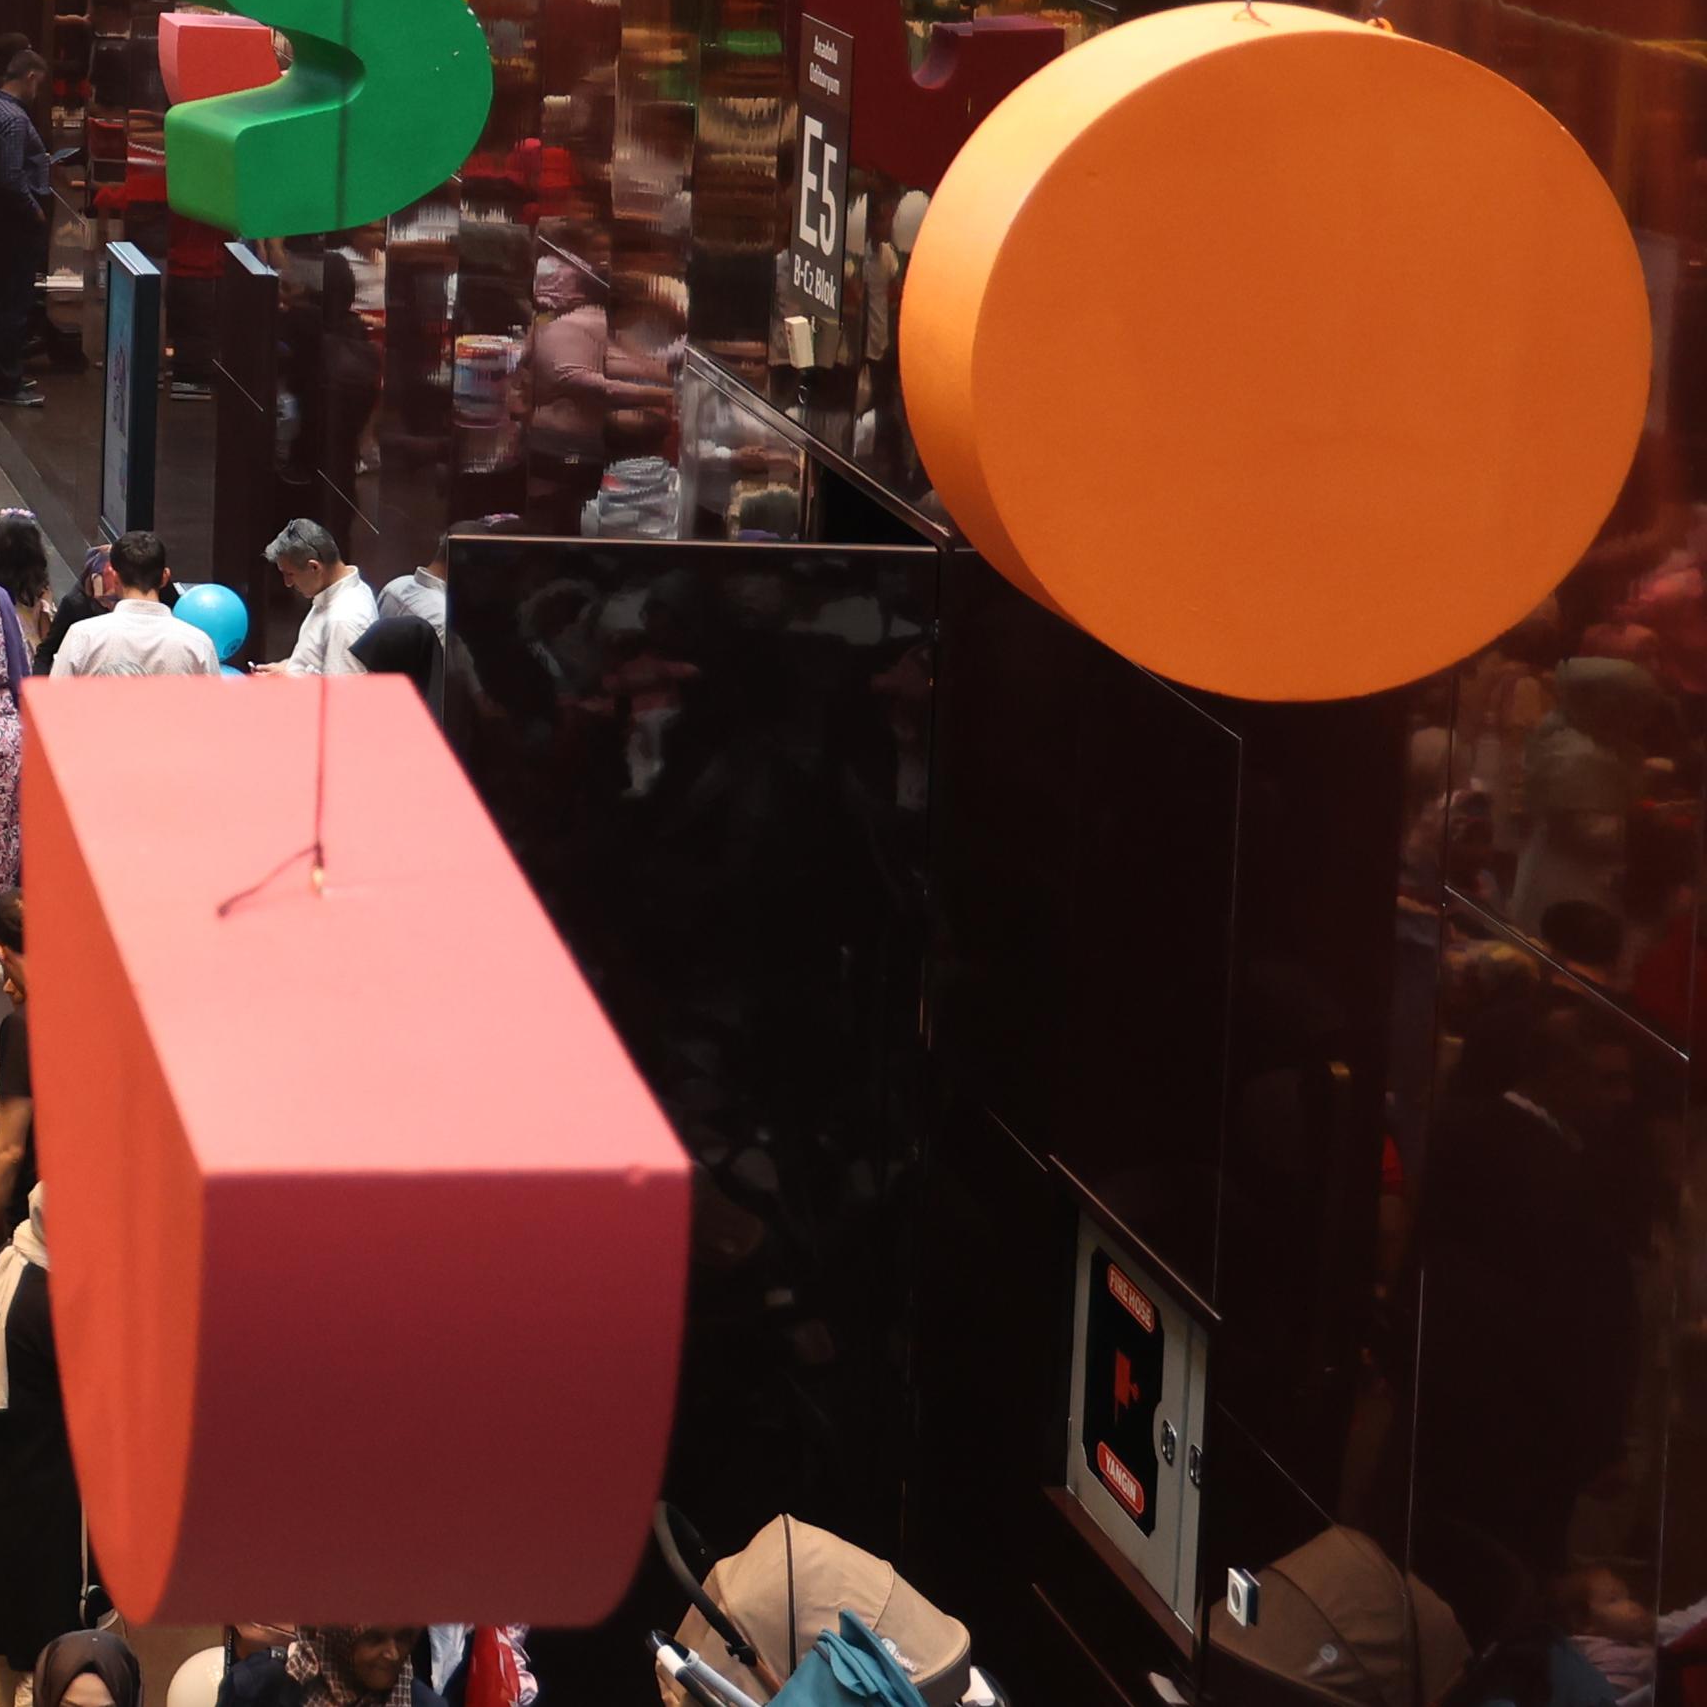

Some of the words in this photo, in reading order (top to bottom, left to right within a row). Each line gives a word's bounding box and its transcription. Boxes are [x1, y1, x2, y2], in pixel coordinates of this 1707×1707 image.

[813, 34, 839, 65] Anadolu
[809, 61, 841, 96] Oditoryum
[799, 114, 838, 257] E5
[815, 266, 836, 311] Blok
[1109, 1270, 1129, 1303] FIRE
[1127, 1294, 1152, 1328] HOSE
[1104, 1453, 1137, 1502] YANGIN
